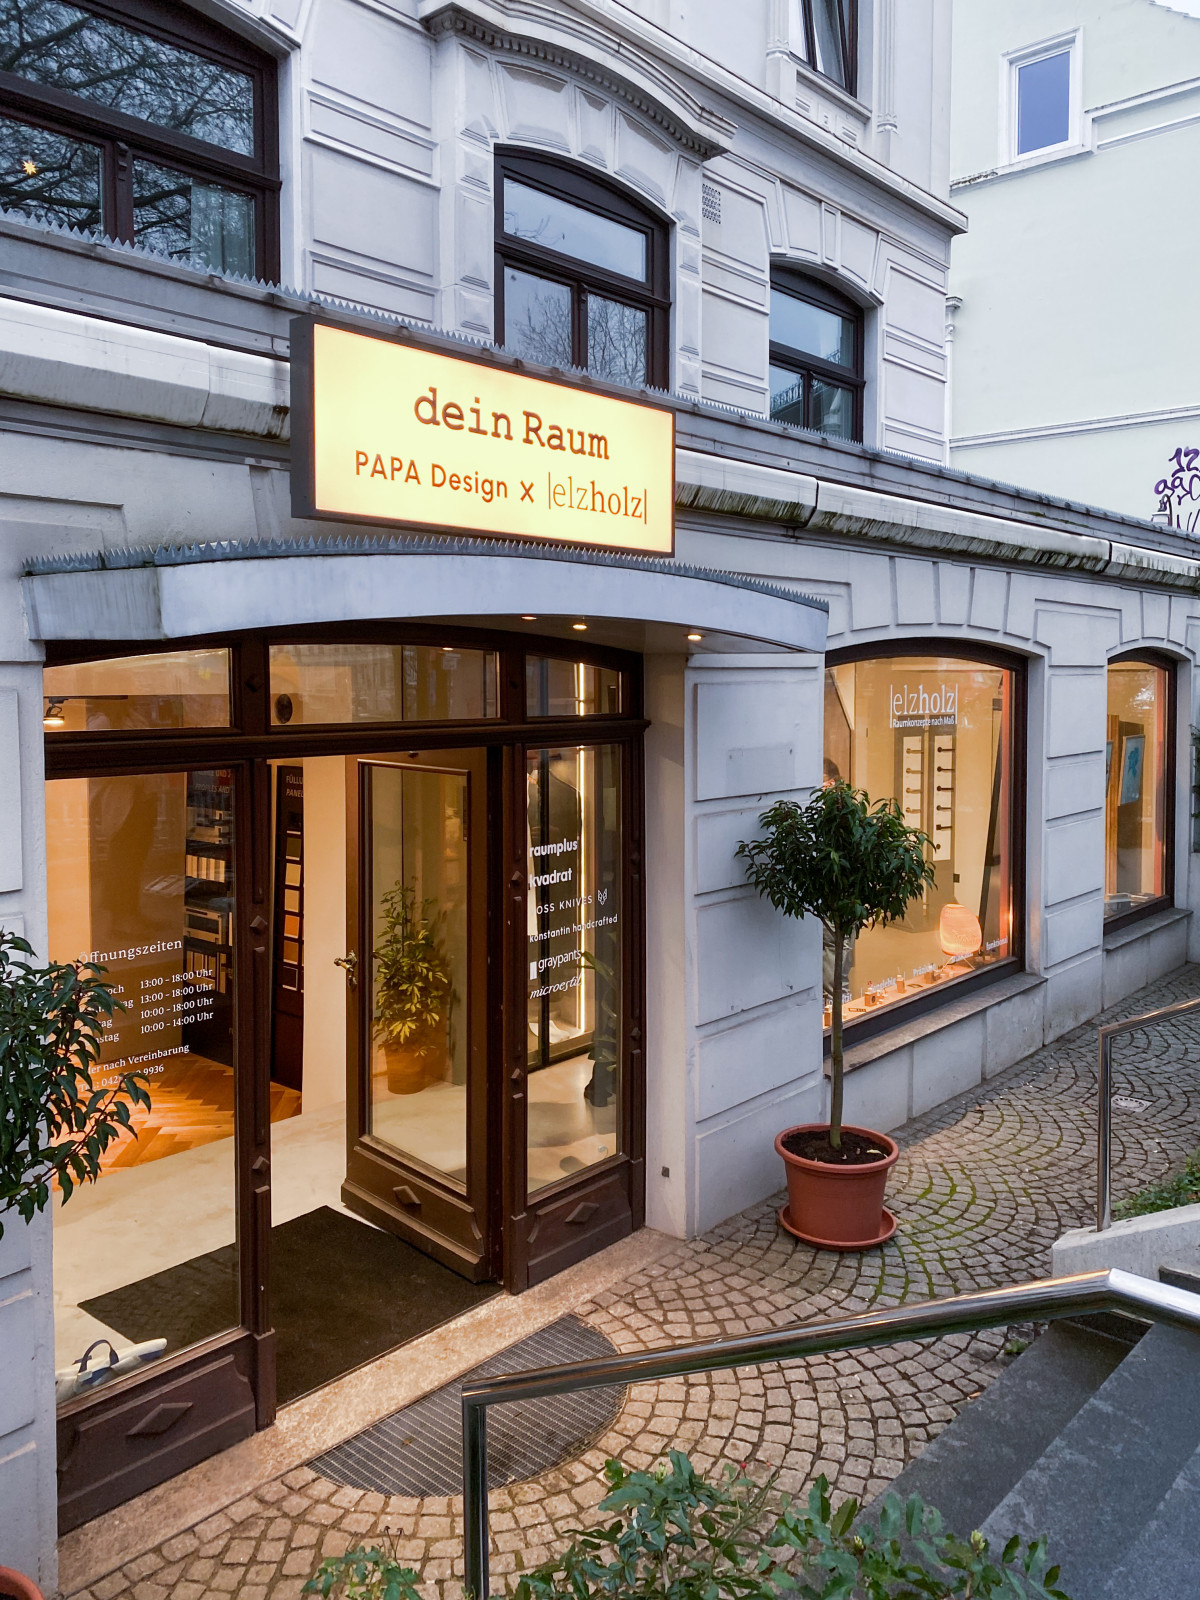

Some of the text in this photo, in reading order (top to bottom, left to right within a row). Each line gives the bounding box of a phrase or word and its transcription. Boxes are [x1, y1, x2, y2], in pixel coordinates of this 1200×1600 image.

[413, 386, 610, 461] dein Raum
[355, 449, 421, 486] PAPA
[431, 463, 508, 503] Design
[893, 715, 955, 729] Raumkonzepte nach Maß
[529, 837, 578, 858] raumplus
[529, 867, 573, 888] kvadrat
[559, 895, 593, 910] KNIVES
[529, 913, 618, 943] konstantin handcrafted
[78, 939, 183, 964] Öffnungszeiten
[538, 949, 581, 973] graypants
[140, 977, 164, 989] 13:00
[171, 971, 194, 984] 18:00
[195, 968, 213, 978] Uhr
[140, 992, 164, 1004] 13:00
[171, 986, 194, 998] 18:00
[195, 982, 213, 992] Uhr
[140, 1006, 164, 1019] 10:00
[172, 1001, 195, 1012] 18:00
[196, 997, 214, 1007] Uhr
[140, 1021, 165, 1034] 10:00
[172, 1016, 195, 1027] 14:00
[196, 1011, 214, 1022] Uhr
[103, 1059, 126, 1072] nach
[128, 1044, 190, 1065] Vereinbarung
[143, 1064, 164, 1077] 9936
